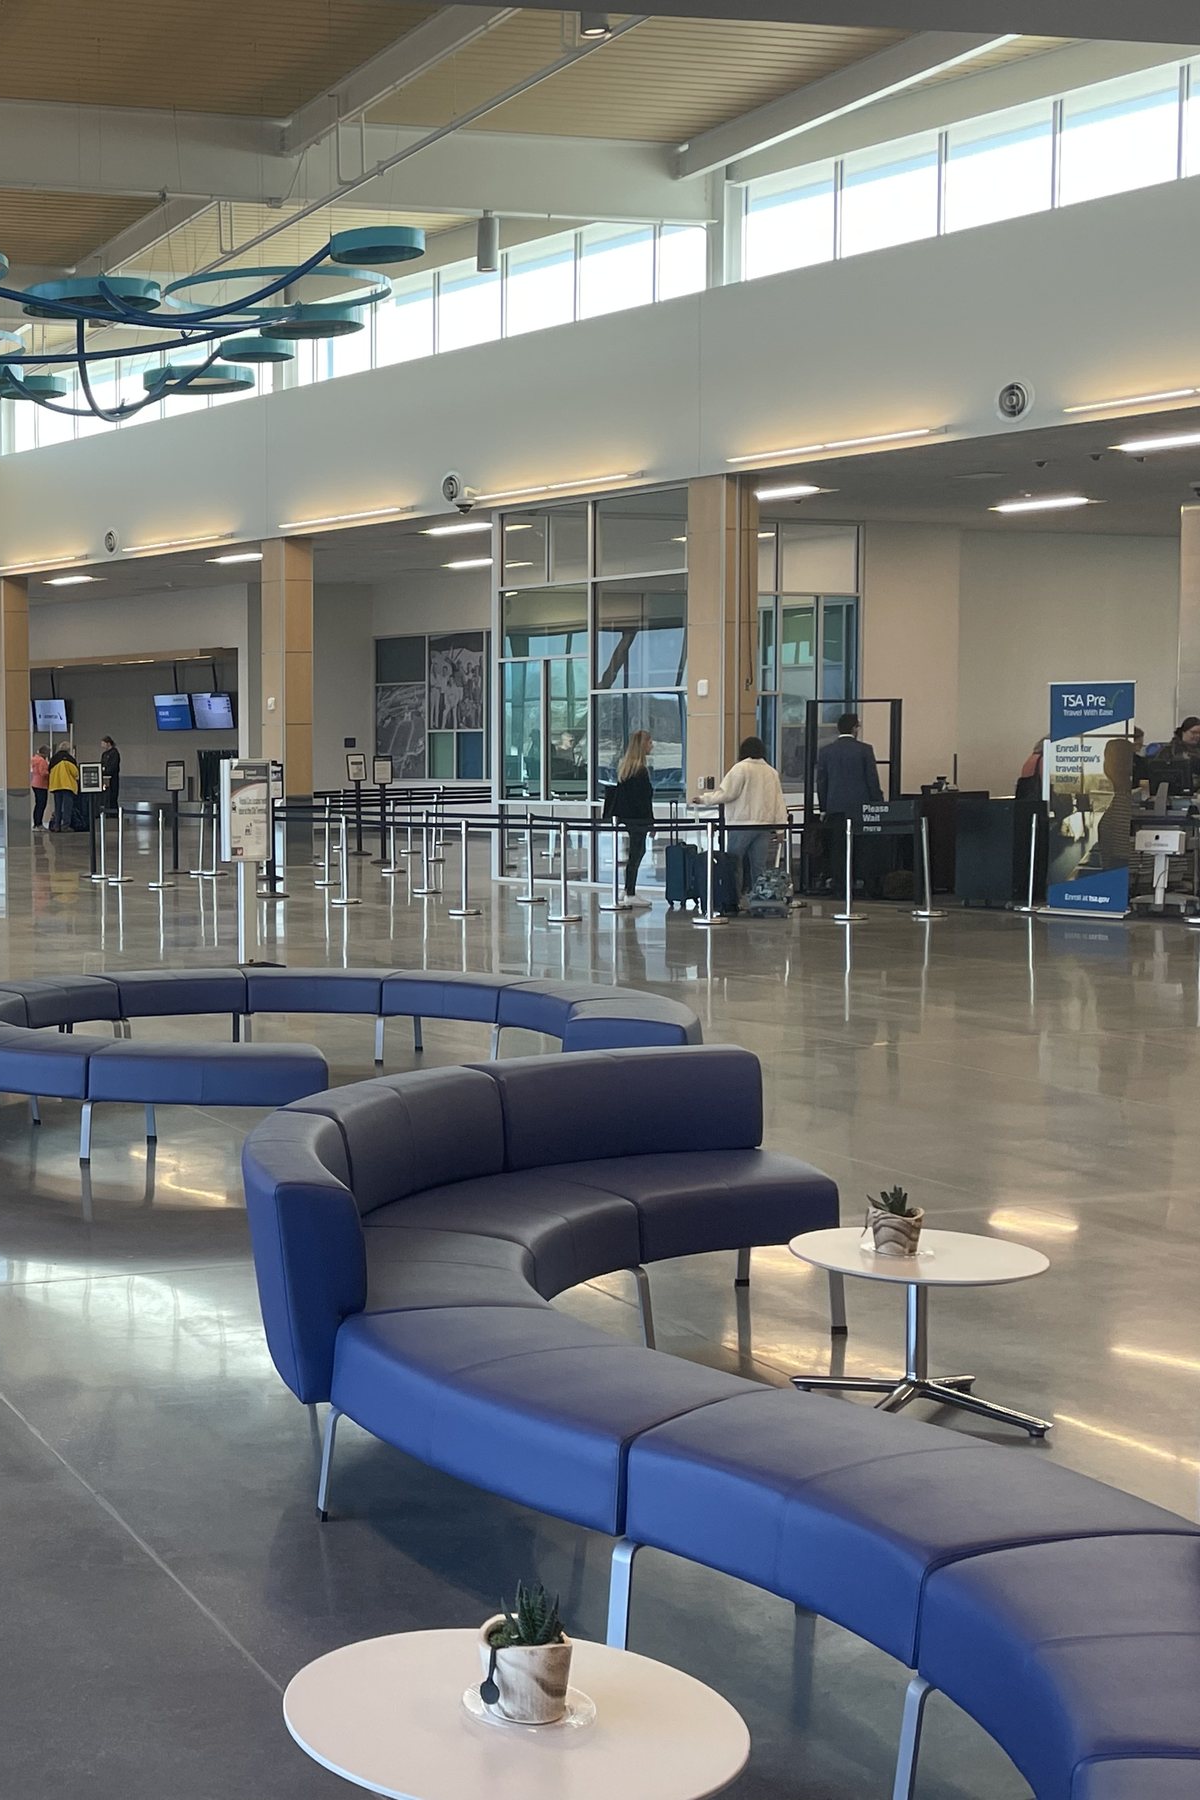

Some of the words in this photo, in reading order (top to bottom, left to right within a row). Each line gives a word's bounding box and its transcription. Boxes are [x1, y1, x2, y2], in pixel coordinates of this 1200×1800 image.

[1062, 695, 1084, 707] TSA
[1087, 694, 1106, 707] Pre
[1056, 745, 1079, 753] Enroll
[1081, 744, 1092, 753] for
[1056, 755, 1100, 763] tomorrow's
[862, 804, 889, 813] Please
[862, 814, 880, 822] Wait
